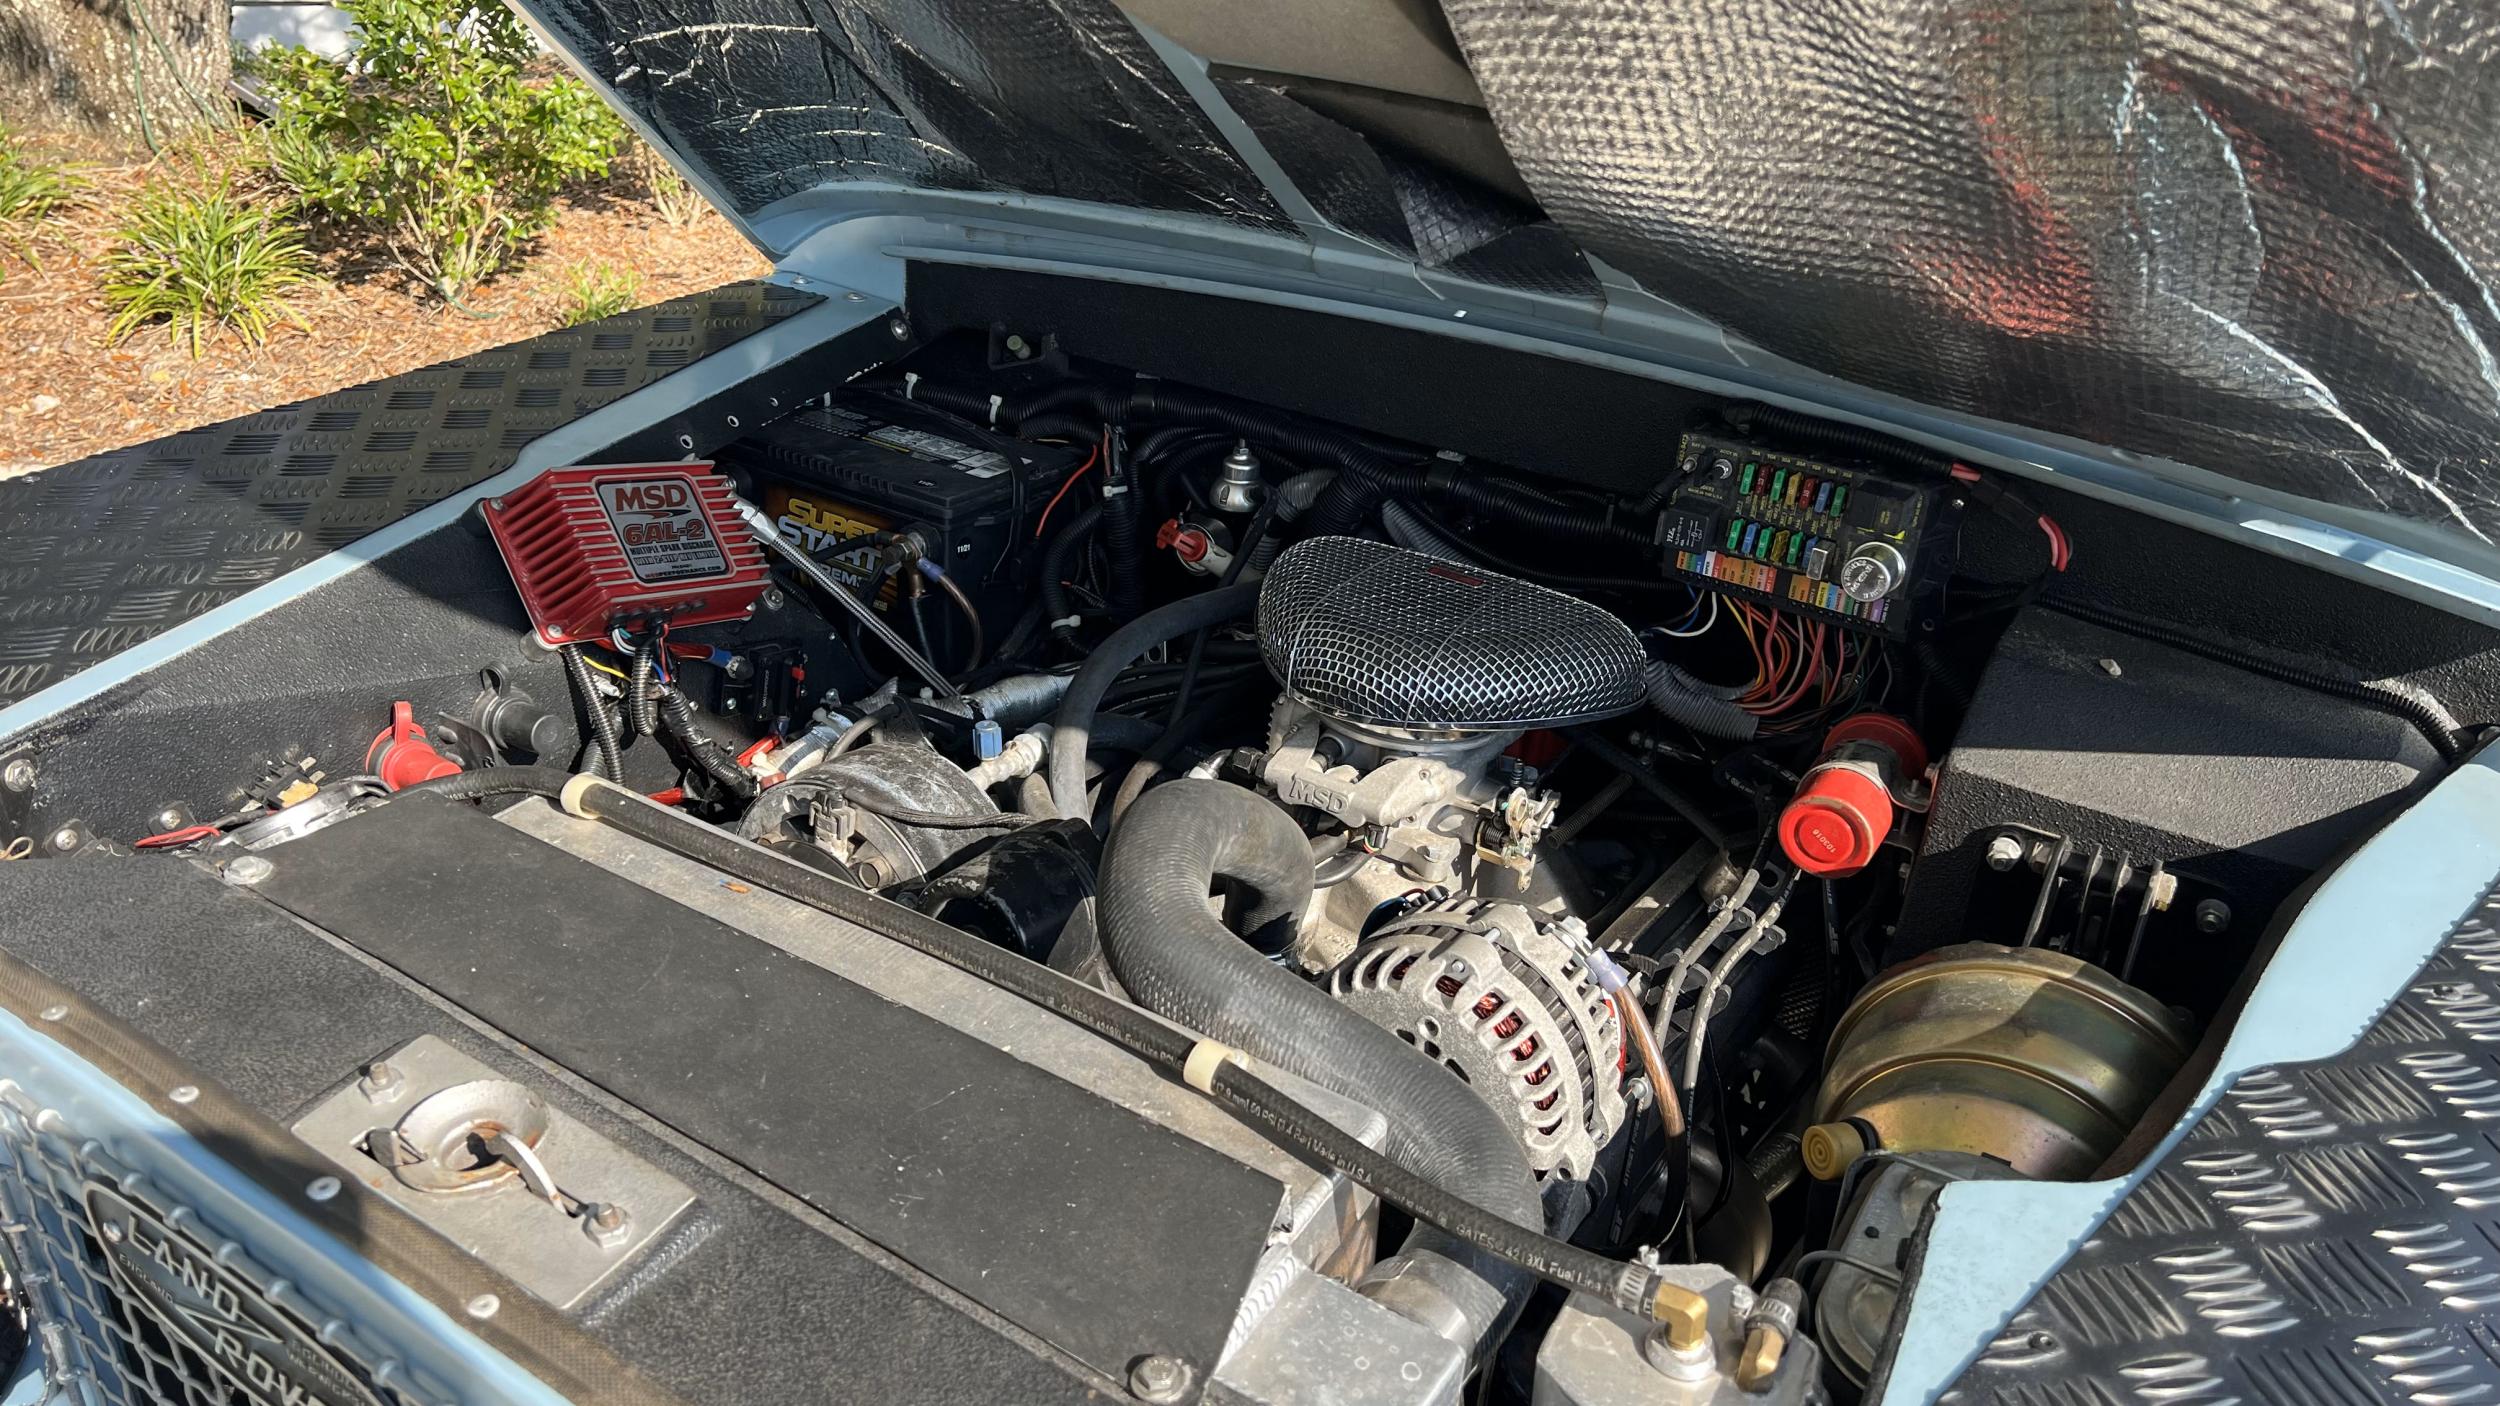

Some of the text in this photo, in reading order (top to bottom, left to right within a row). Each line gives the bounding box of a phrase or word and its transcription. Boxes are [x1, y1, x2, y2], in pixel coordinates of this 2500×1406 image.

[615, 484, 688, 512] MSD
[623, 518, 706, 546] 6AL-2
[660, 542, 683, 553] SPARK
[683, 540, 716, 551] DISCHARGE
[633, 556, 655, 566] WITH
[1289, 778, 1349, 814] MSD
[1313, 1139, 1336, 1161] Made
[1336, 1155, 1346, 1168] in
[119, 1252, 175, 1304] ENGLAND
[127, 1214, 240, 1322] LAND
[1548, 1261, 1575, 1284] Fuel
[1577, 1269, 1602, 1291] Line
[215, 1329, 326, 1406] ROV
